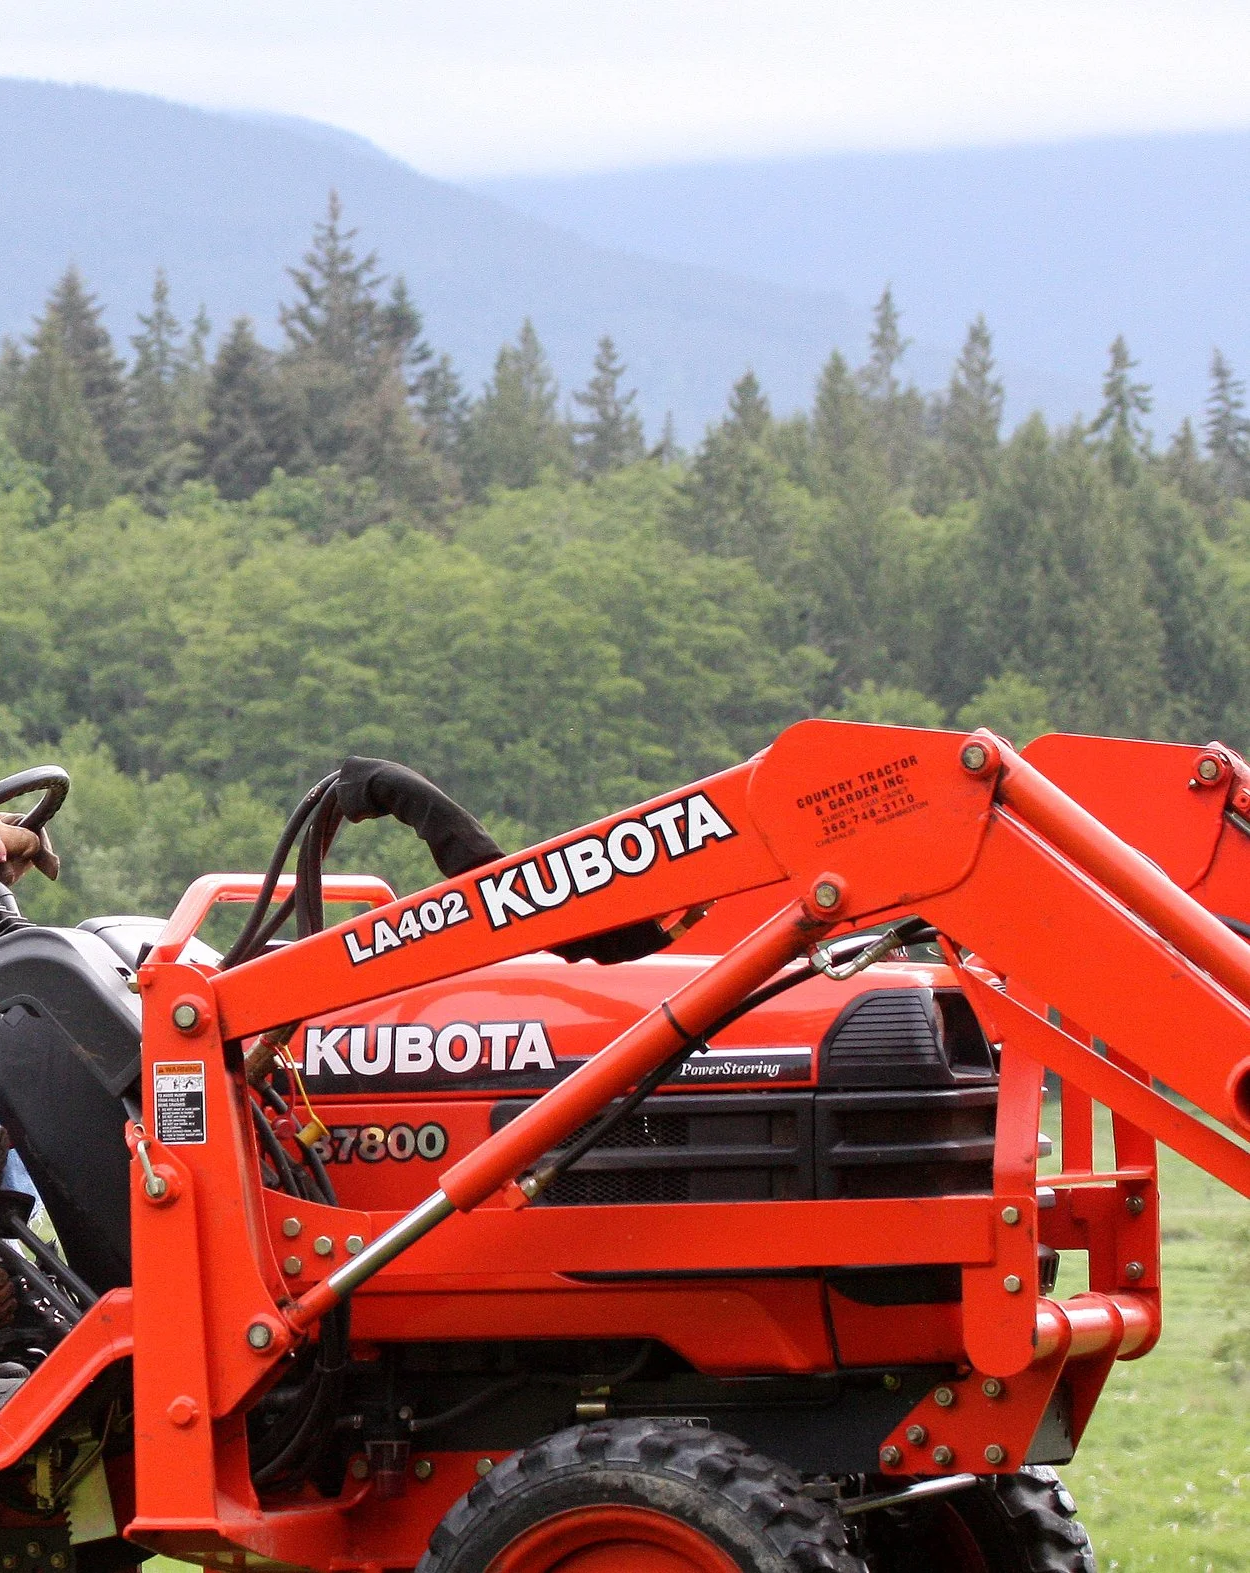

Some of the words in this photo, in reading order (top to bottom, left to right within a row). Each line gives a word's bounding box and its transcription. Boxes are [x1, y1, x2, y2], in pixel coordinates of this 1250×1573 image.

[797, 779, 853, 809] COUNTRY
[858, 755, 919, 785] TRACTOR
[814, 805, 824, 816] &
[829, 784, 880, 811] GARDEN
[883, 774, 910, 790] INC.
[823, 793, 914, 836] 360-748-3110
[343, 890, 470, 964] LA402
[478, 793, 735, 930] KUBOTA
[305, 1021, 556, 1076] KUBOTA
[680, 1061, 780, 1077] PowerSteering
